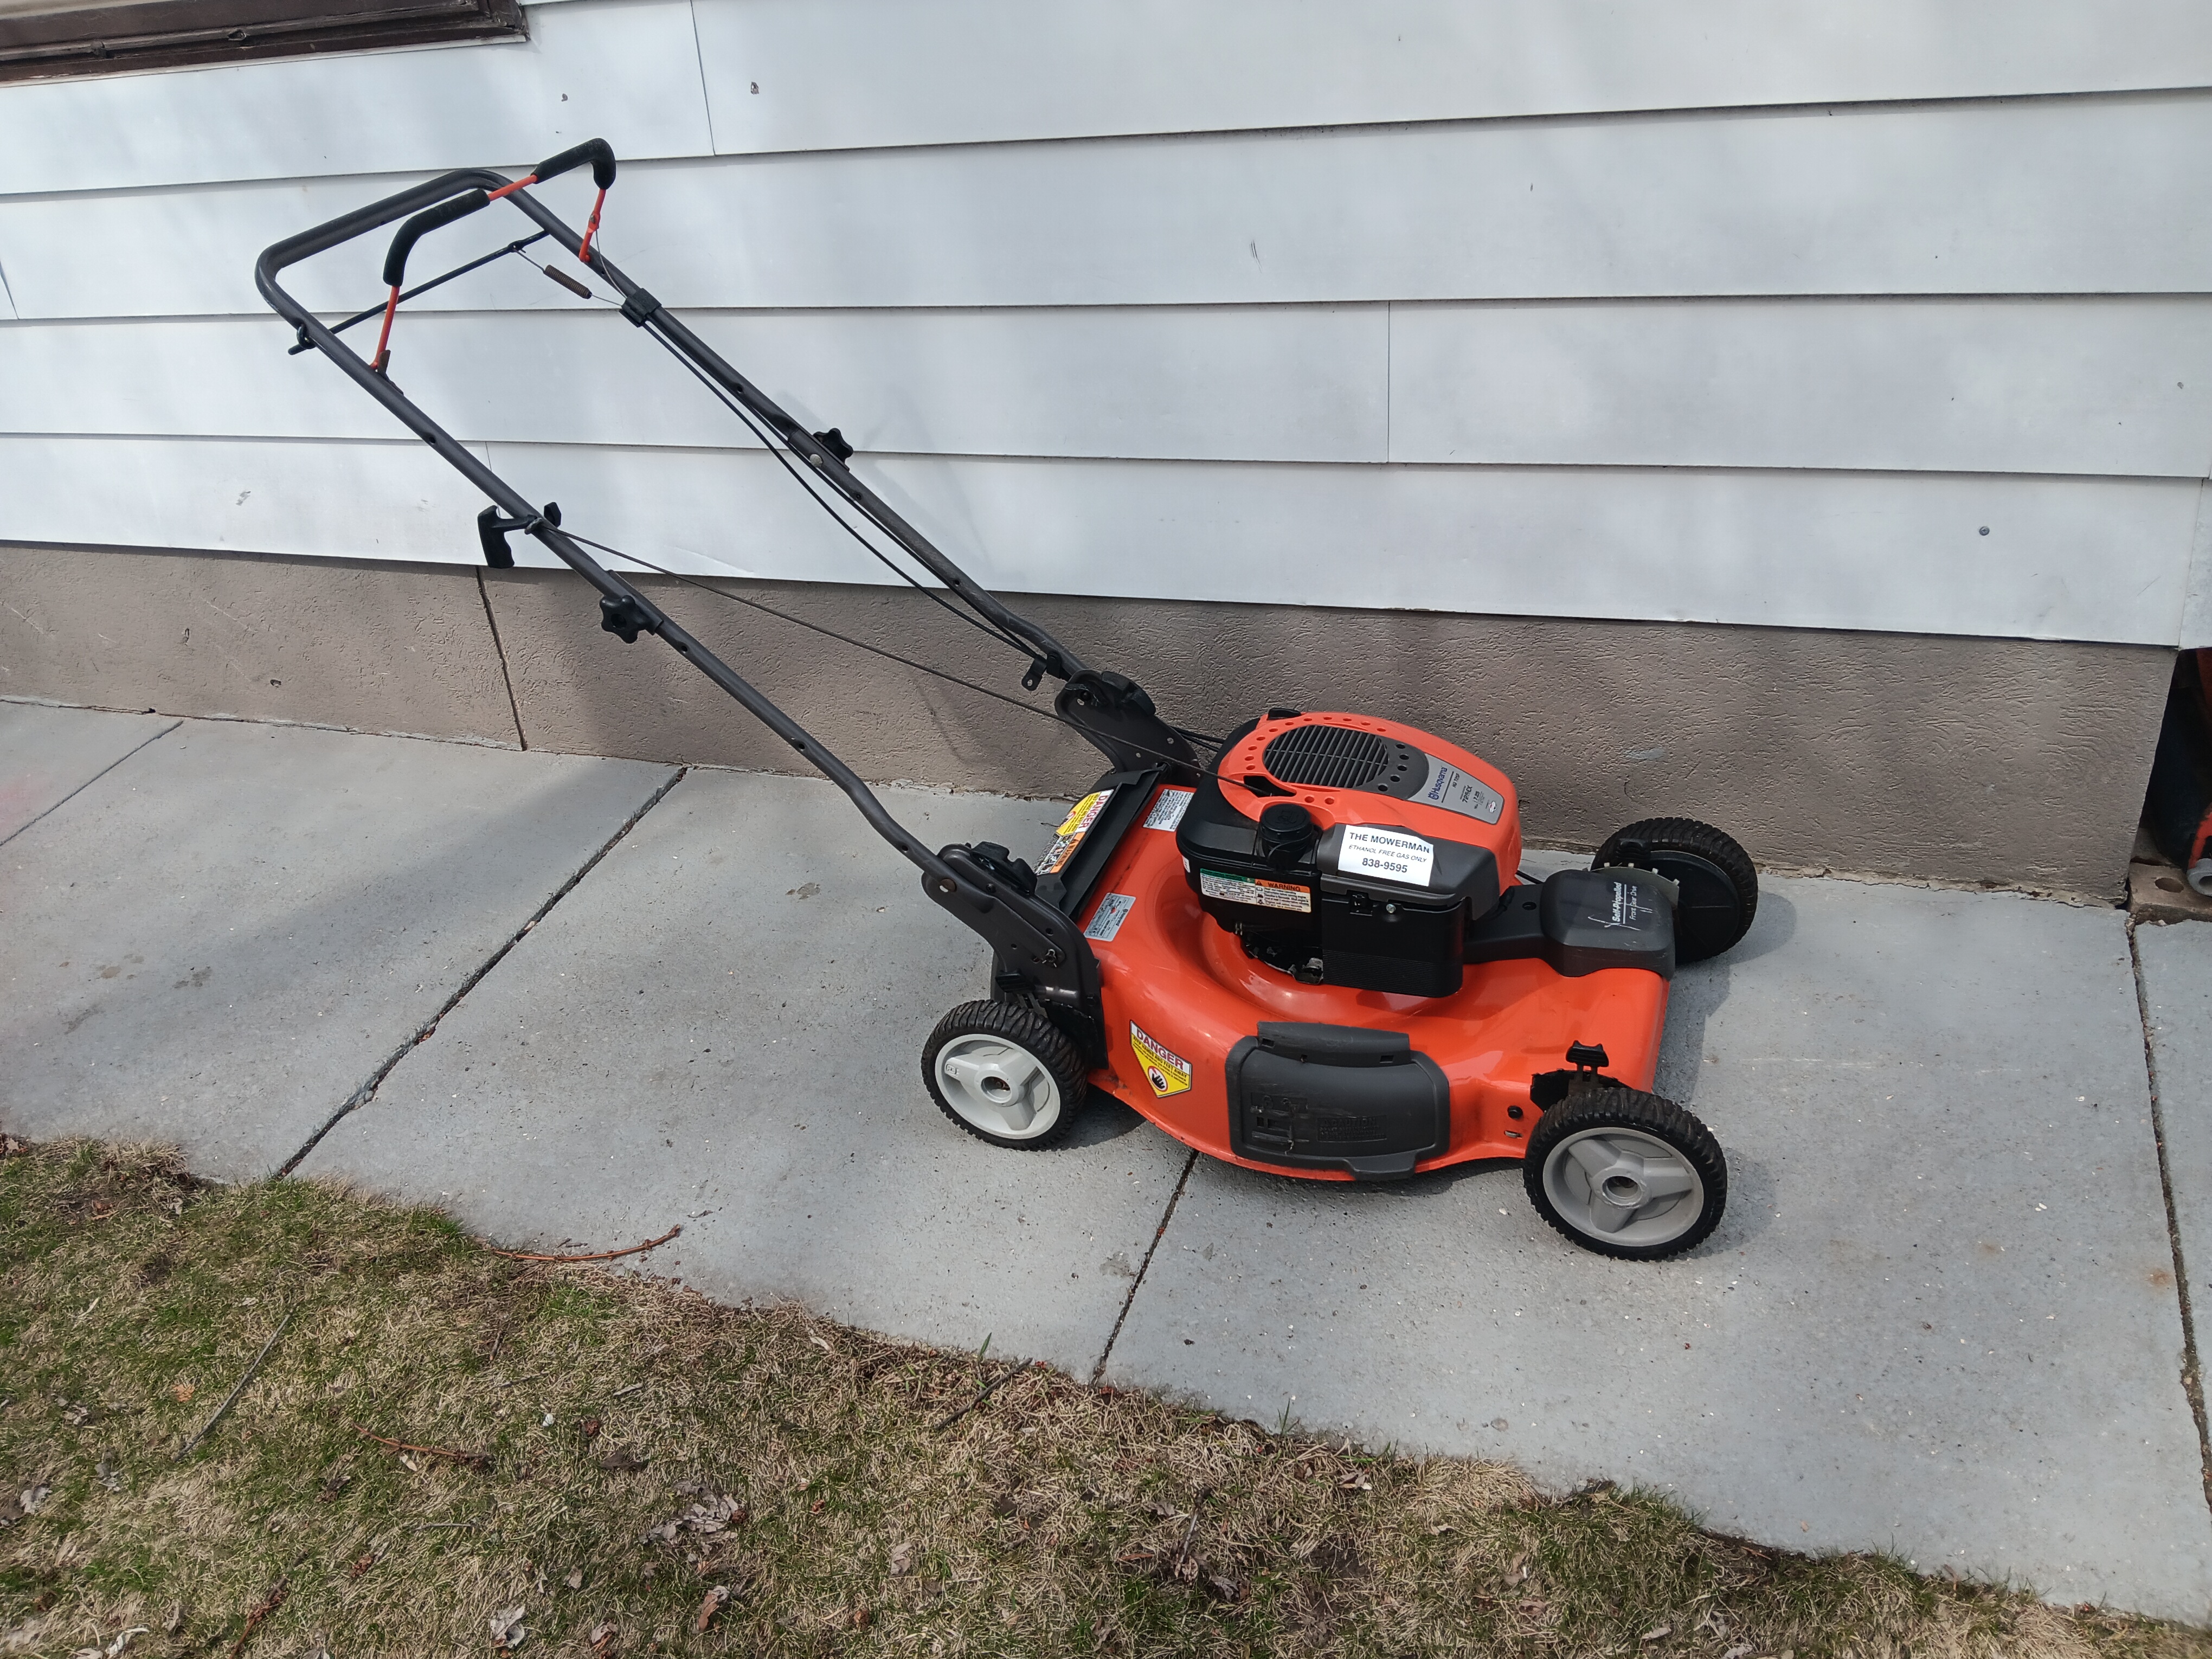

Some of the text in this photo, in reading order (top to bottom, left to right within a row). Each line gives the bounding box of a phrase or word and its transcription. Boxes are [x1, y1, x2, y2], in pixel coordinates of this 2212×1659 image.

[1431, 767, 1448, 794] Husqvarna
[1078, 795, 1108, 828] DANGER
[1348, 844, 1377, 854] ETHANOL
[1349, 832, 1430, 853] THE MOWERMAN
[1362, 858, 1408, 873] 838-9595
[1268, 882, 1301, 892] WARNING
[1612, 882, 1623, 922] Self-Propelled
[1136, 1027, 1184, 1071] DANGER
